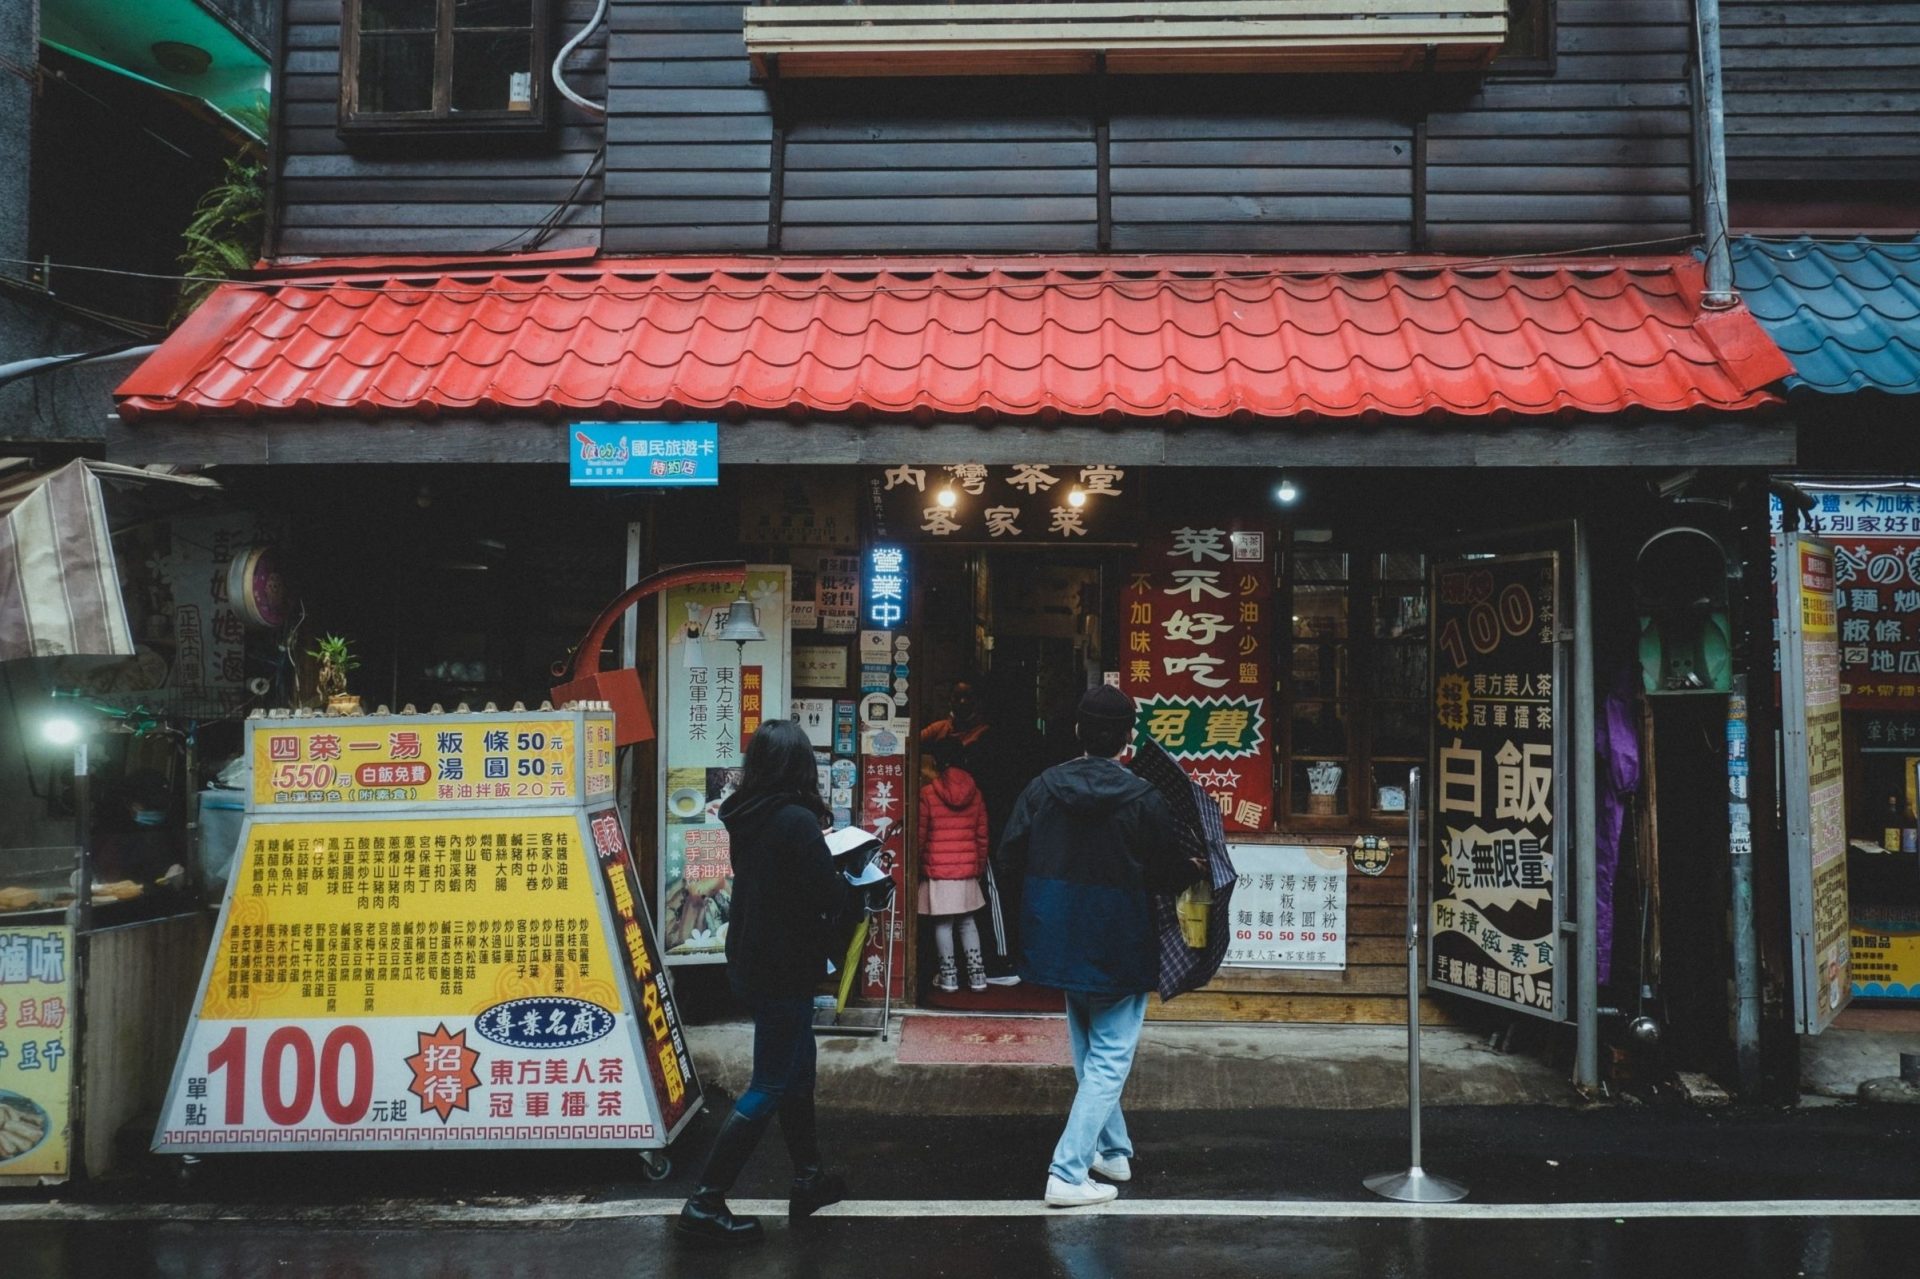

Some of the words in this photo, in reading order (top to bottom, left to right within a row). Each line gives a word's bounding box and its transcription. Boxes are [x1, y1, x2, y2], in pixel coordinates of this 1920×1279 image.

[632, 439, 715, 457] 國民旅遊卡
[651, 458, 697, 477] 特約店
[884, 463, 1124, 497] 內灣茶堂
[920, 504, 1088, 537] 客家菜
[871, 548, 903, 627] 營業中
[1161, 526, 1234, 689] 菜不好吃
[1129, 572, 1152, 683] 不加味素
[1440, 583, 1534, 669] 100
[689, 666, 708, 741] 冠軍擂茶
[743, 672, 761, 734] 無限量
[1473, 673, 1552, 697] 東方美人茶
[716, 666, 735, 760] 東方美人茶
[1147, 708, 1249, 748] 免費
[1473, 704, 1552, 729] 冠軍擂茶
[270, 731, 421, 762] 四菜一湯
[437, 730, 510, 754] 粄條
[517, 732, 546, 751] 50
[551, 736, 563, 750] 元
[338, 775, 352, 787] 元
[362, 765, 428, 783] 白飯免費
[438, 756, 509, 781] 湯圓
[517, 758, 546, 777] 50
[551, 762, 564, 776] 元
[438, 783, 511, 799] 豬油拌飯
[517, 783, 544, 797] 20
[550, 781, 566, 797] 元
[867, 764, 903, 777] 本店特色
[1439, 737, 1553, 826] 白飯
[357, 837, 370, 910] 酸菜炒牛肉
[372, 836, 385, 910] 酸菜山豬肉
[419, 835, 431, 893] 宮保雞丁
[434, 835, 447, 893] 梅干扣肉
[449, 835, 462, 892] 內灣溪蝦
[465, 834, 477, 892] 炒山豬肉
[495, 833, 508, 892] 薑絲大腸
[526, 833, 539, 891] 三杯中卷
[541, 832, 554, 891] 客家小炒
[556, 832, 569, 891] 桔醬油雞
[685, 864, 735, 882] 豬油拌
[1471, 838, 1544, 889] 無限量
[1322, 876, 1339, 929] 湯米粉
[0, 933, 65, 984] 滷味
[517, 919, 527, 979] 客家茄子
[579, 918, 589, 977] 炒高麗菜
[1236, 929, 1252, 940] 60
[1257, 930, 1273, 940] 50
[1279, 931, 1294, 941] 50
[1300, 931, 1316, 942] 50
[1321, 932, 1337, 942] 50
[1436, 903, 1554, 969] 附精緻素食
[1438, 954, 1448, 982] 手工
[17, 997, 65, 1028] 豆腸
[493, 1009, 597, 1037] 專業名廚
[18, 1040, 65, 1072] 豆干
[207, 1024, 374, 1126] 100
[372, 1098, 408, 1122] 元起
[422, 1043, 463, 1104] 招待
[489, 1058, 624, 1085] 東方美人茶
[184, 1077, 207, 1126] 單點
[489, 1090, 623, 1118] 冠軍擂茶
